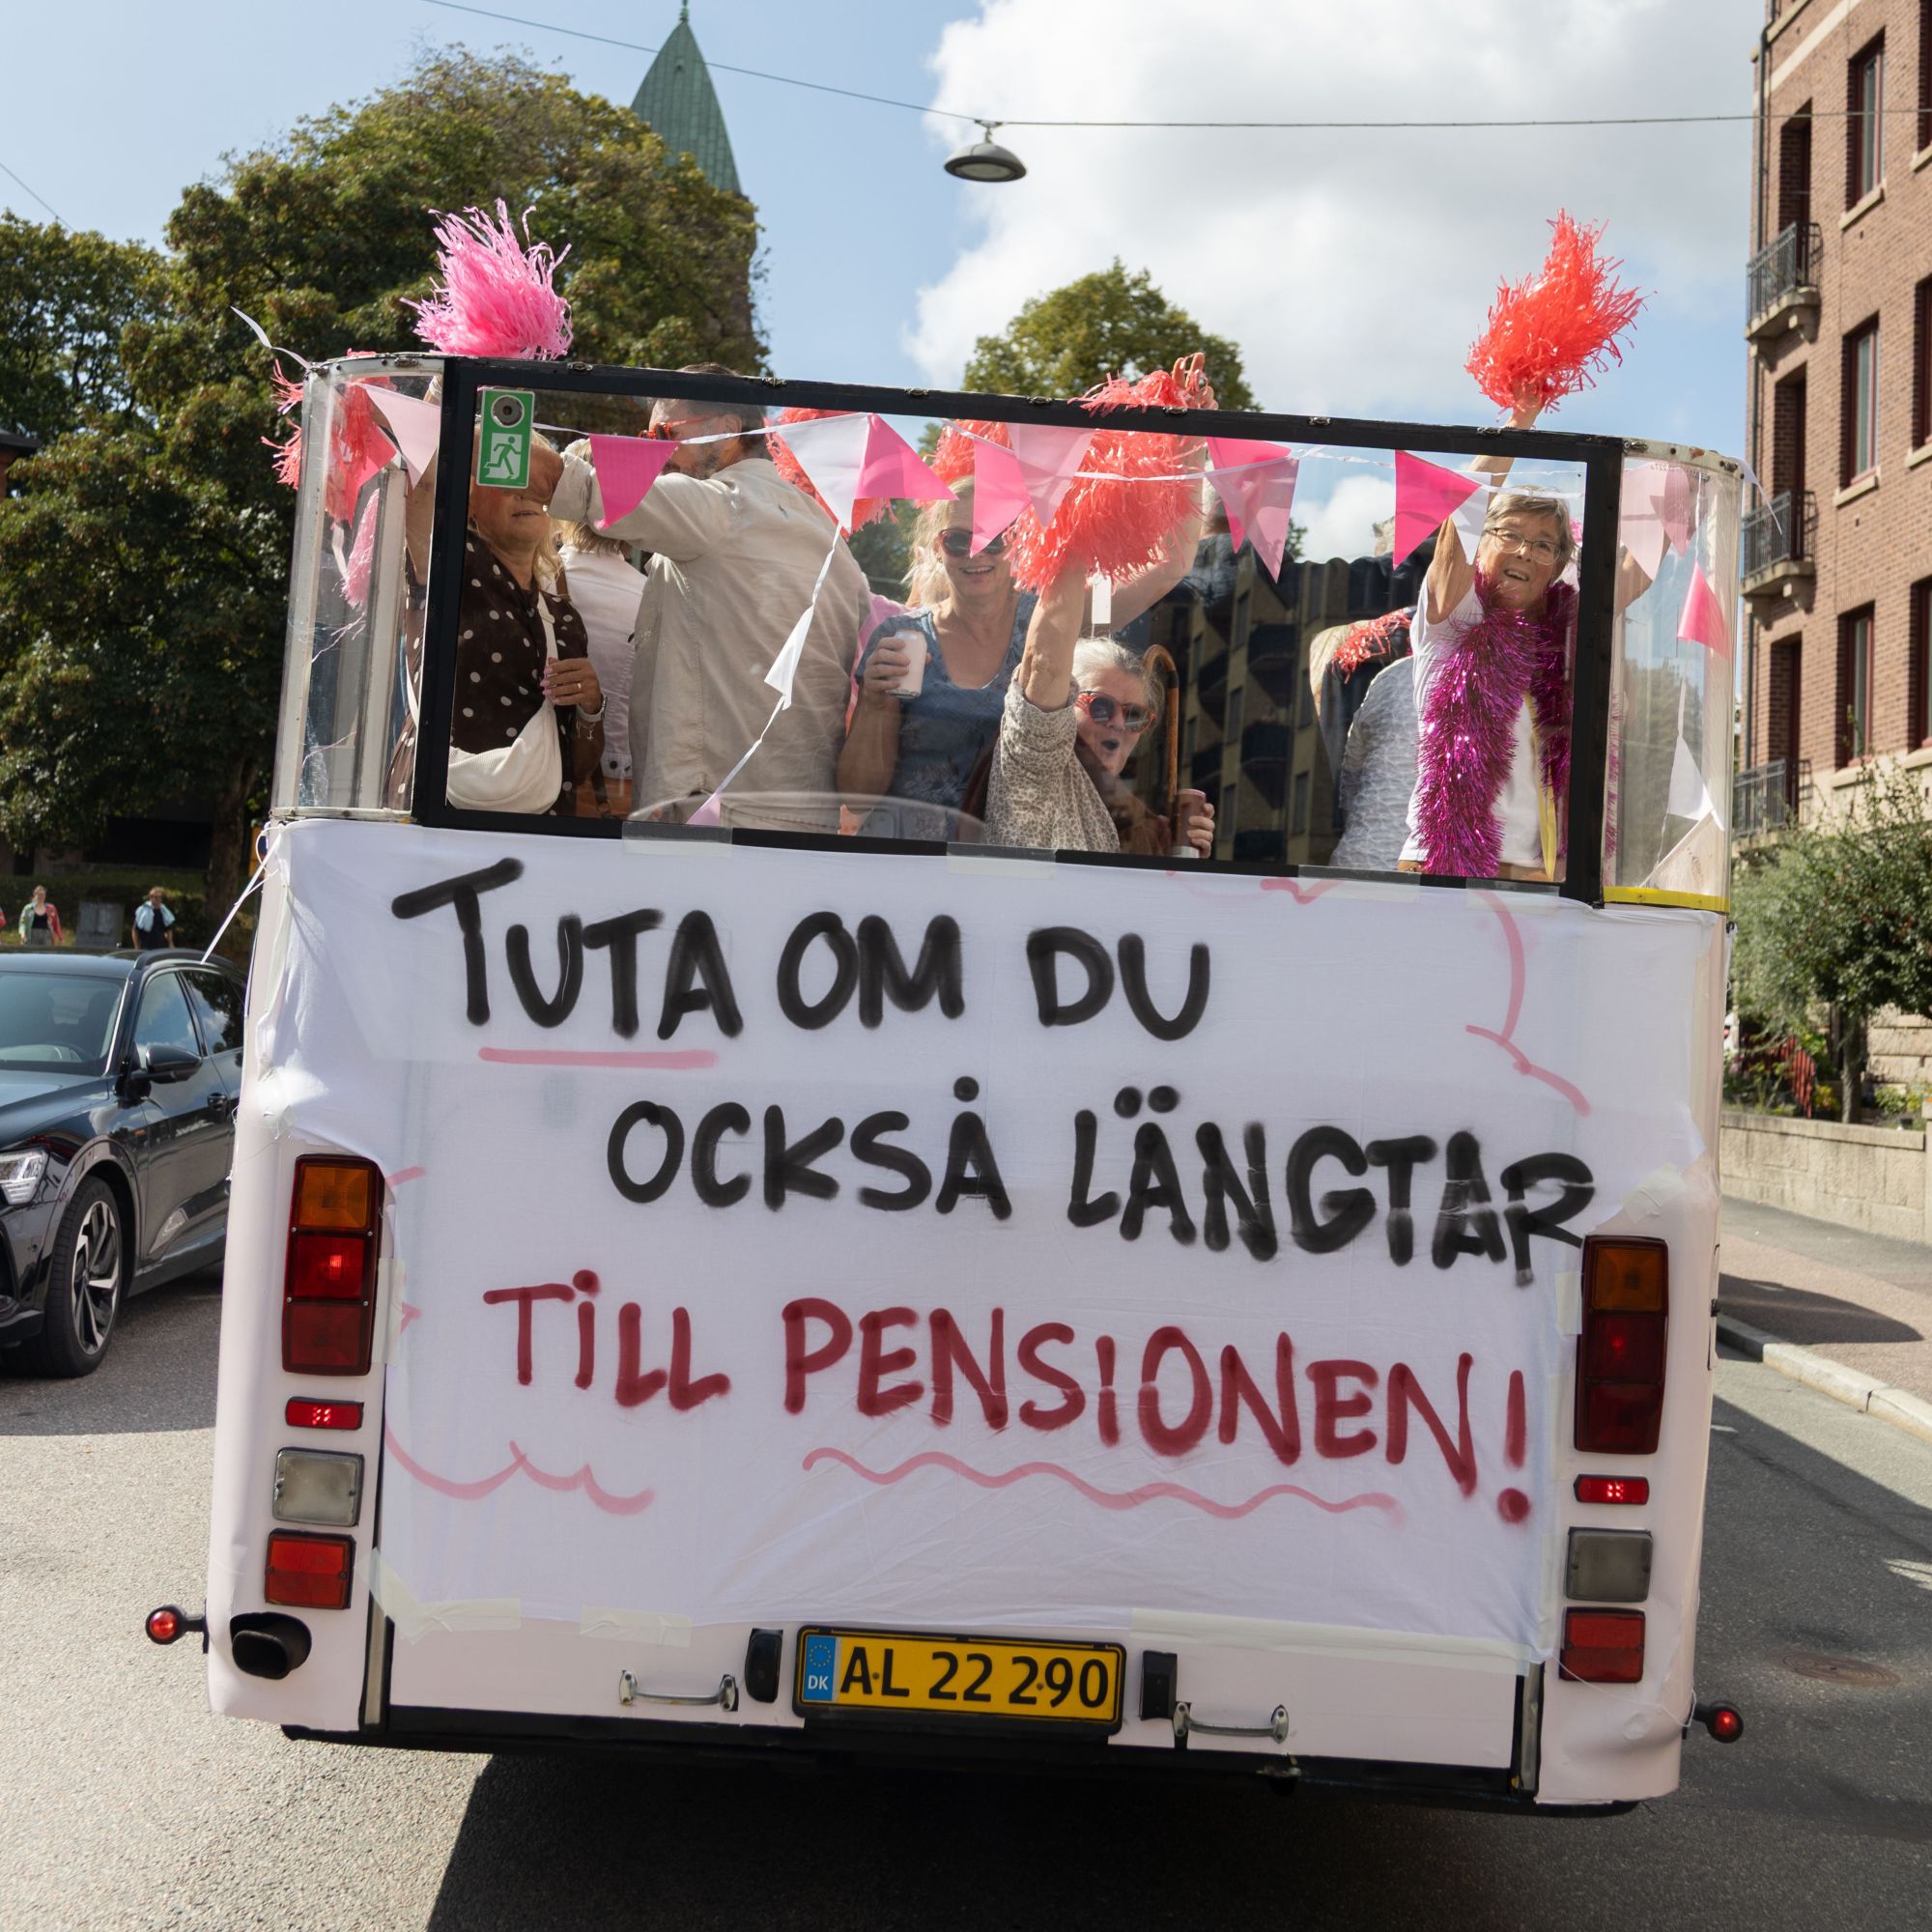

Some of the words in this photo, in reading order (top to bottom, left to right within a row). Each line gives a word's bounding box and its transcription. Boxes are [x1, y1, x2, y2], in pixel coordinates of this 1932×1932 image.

[391, 857, 743, 1040] TUTA
[777, 911, 965, 1030] OM
[1026, 926, 1209, 1041] DU
[608, 1076, 1012, 1221] OCKSÅ
[1067, 1086, 1595, 1288] LÄNGTAR
[781, 1297, 1532, 1524] PENSIONEN!
[808, 1674, 830, 1691] DK
[840, 1646, 910, 1697] AL
[928, 1652, 993, 1702] 22
[1009, 1655, 1109, 1708] 290
